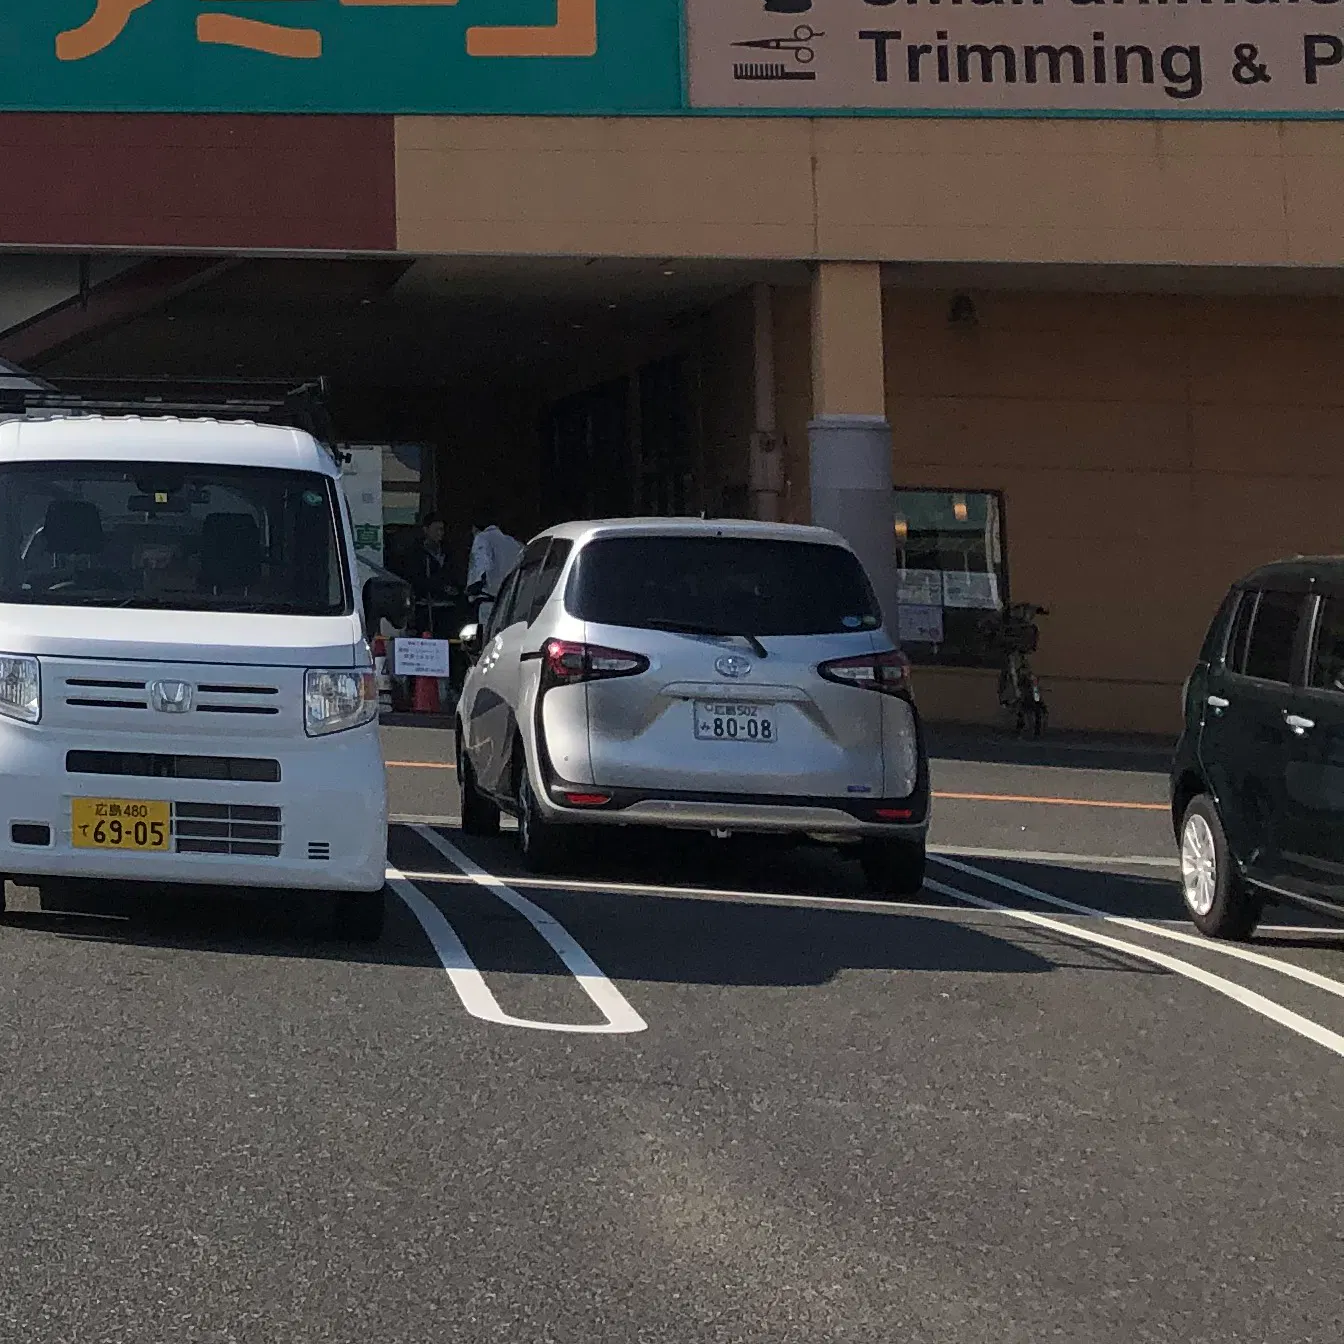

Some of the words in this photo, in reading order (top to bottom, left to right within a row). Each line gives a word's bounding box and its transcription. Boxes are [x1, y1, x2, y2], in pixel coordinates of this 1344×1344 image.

[858, 31, 1203, 99] Trimming
[1232, 43, 1271, 85] &
[713, 718, 772, 738] 80-08
[93, 820, 165, 846] 69-05
